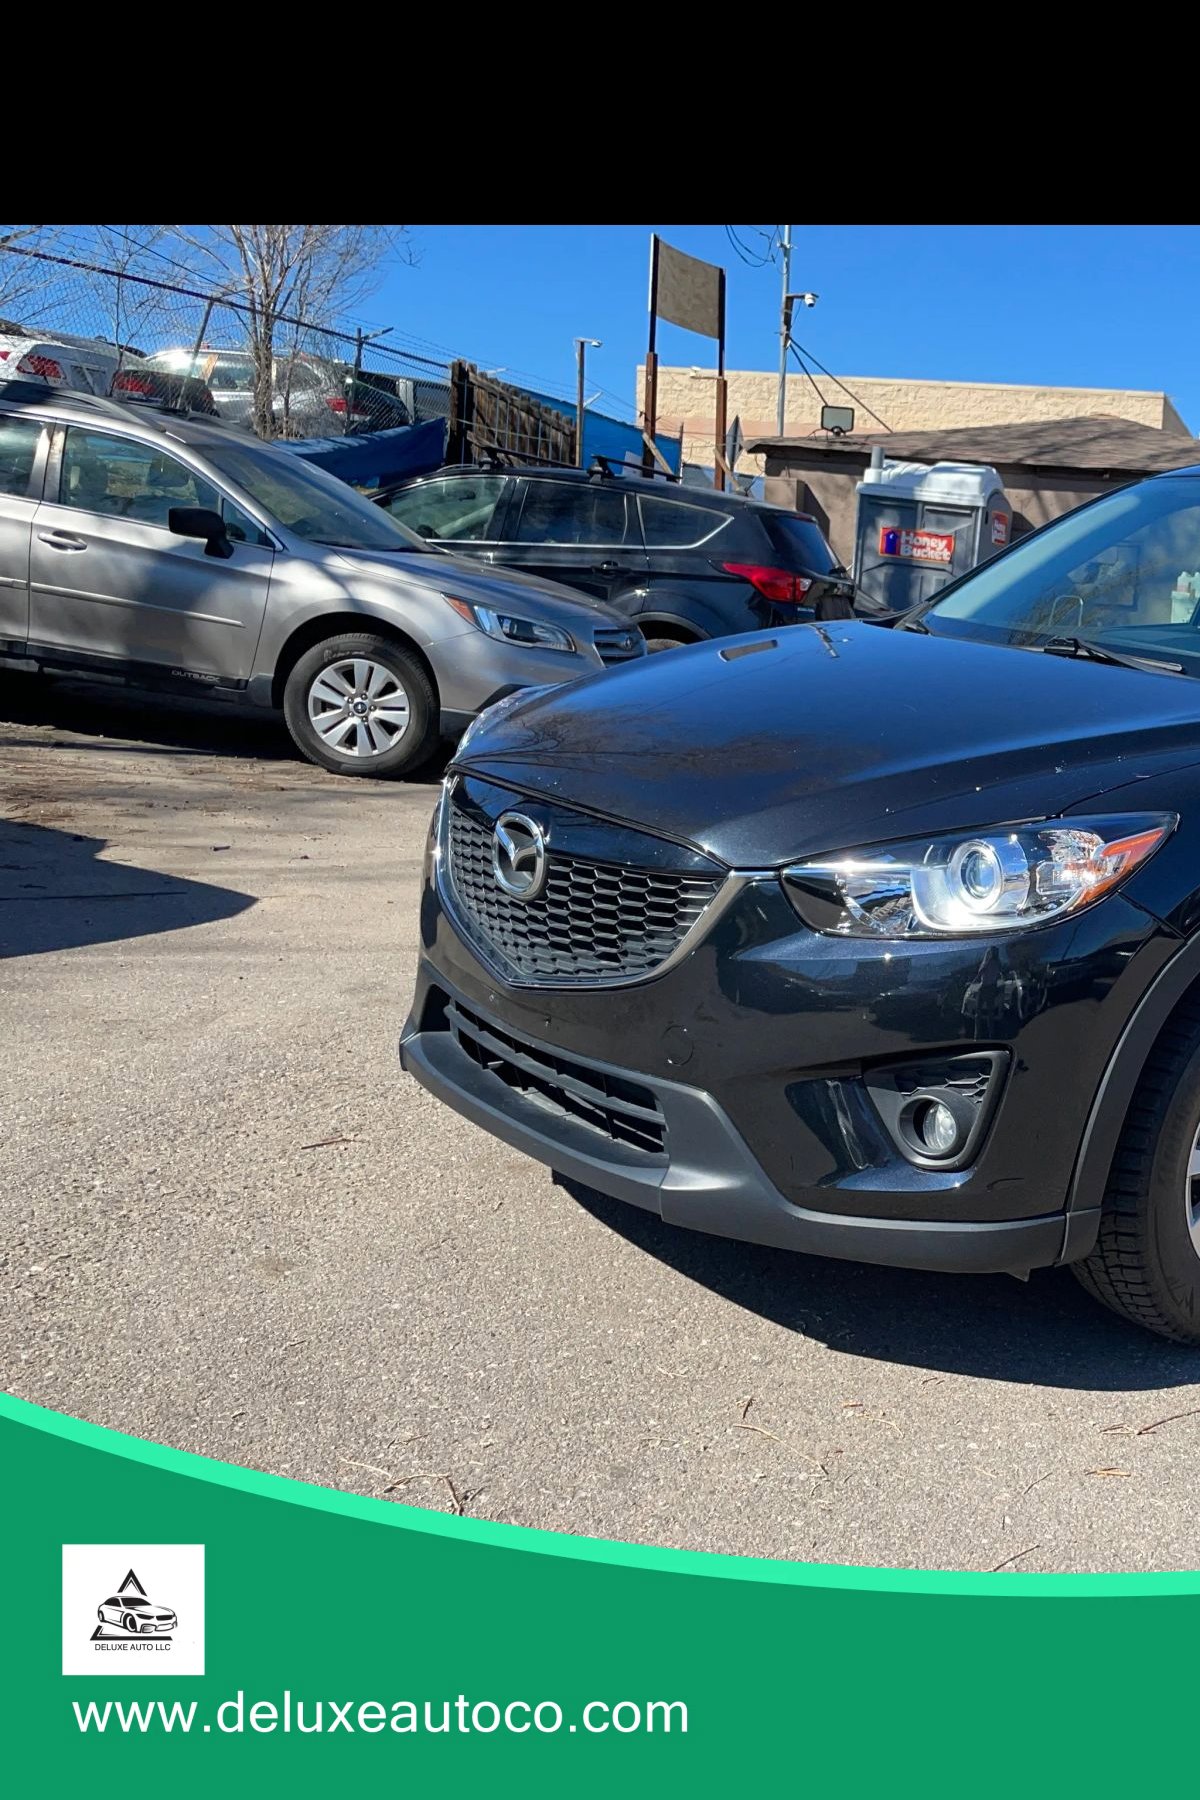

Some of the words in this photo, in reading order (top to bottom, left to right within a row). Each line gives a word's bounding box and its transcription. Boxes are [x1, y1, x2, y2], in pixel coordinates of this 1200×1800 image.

[901, 531, 947, 548] Honey
[901, 544, 951, 561] Bucket
[172, 670, 220, 682] OUTBACK
